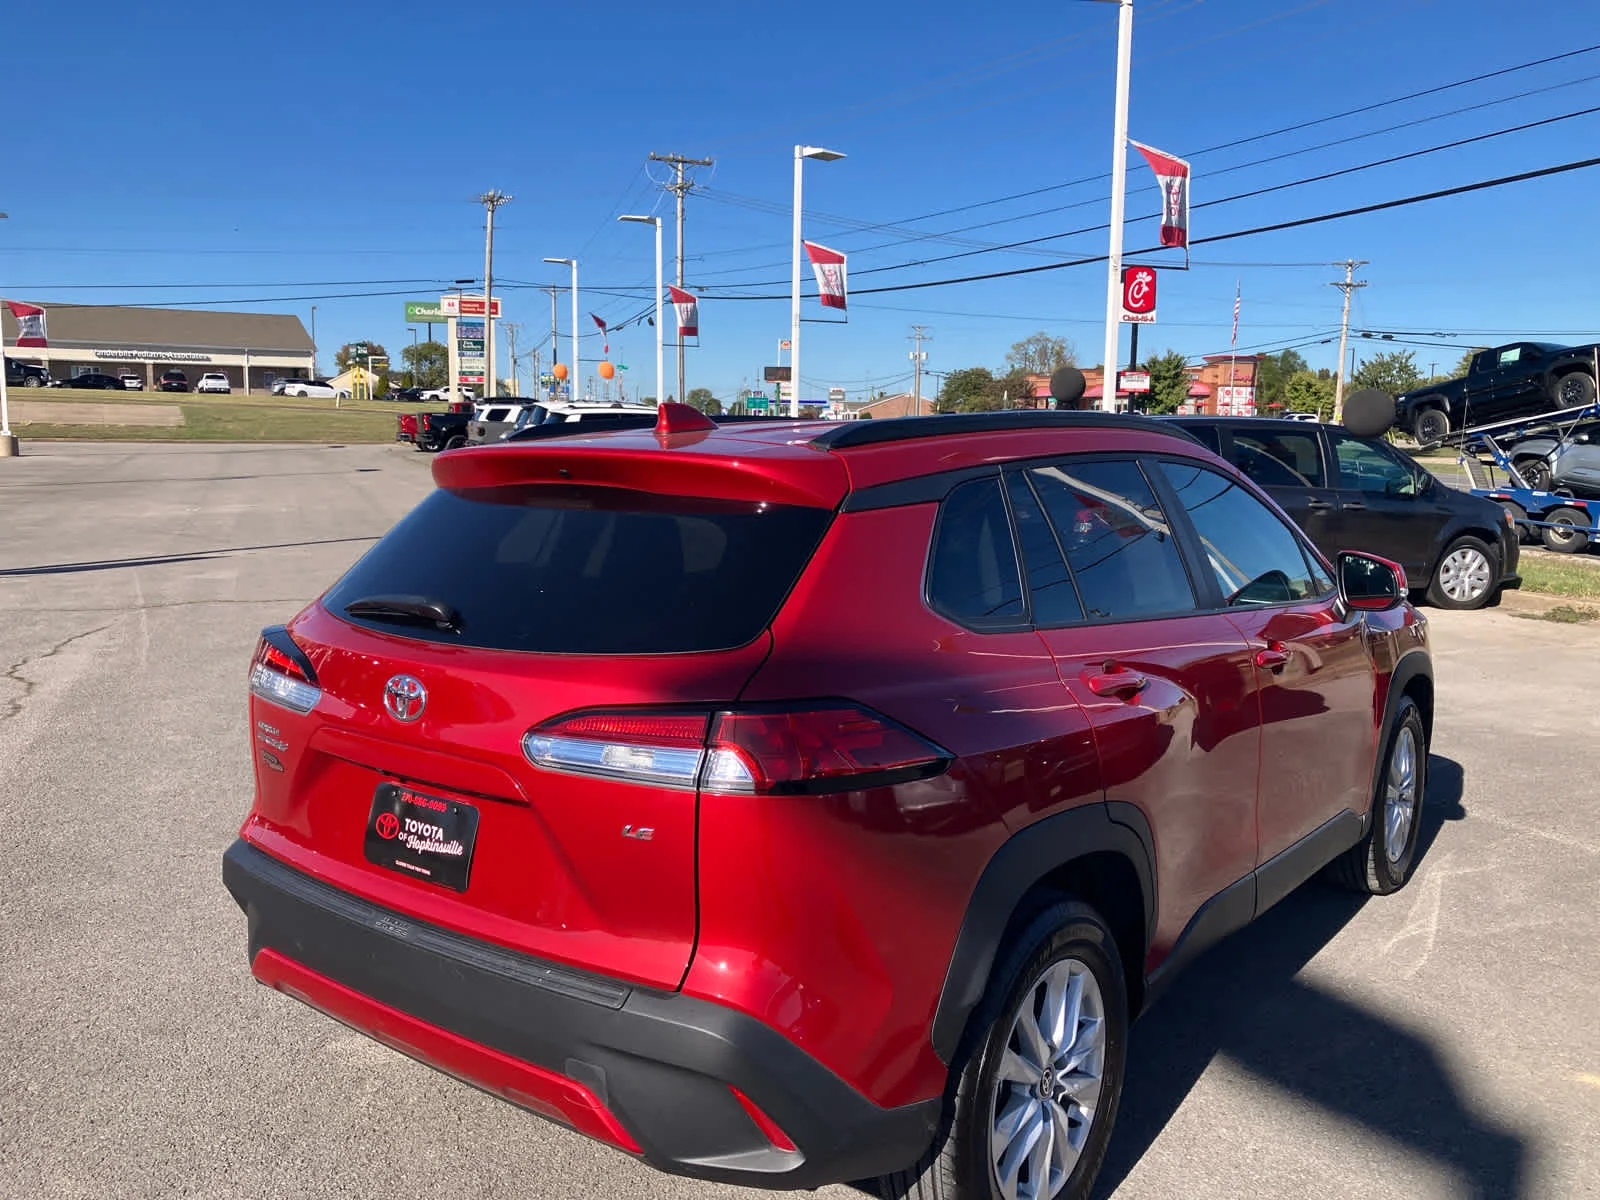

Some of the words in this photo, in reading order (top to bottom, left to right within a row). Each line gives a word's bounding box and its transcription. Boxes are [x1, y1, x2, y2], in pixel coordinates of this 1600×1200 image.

[405, 818, 443, 841] TOYOTA
[398, 832, 408, 841] OF
[406, 835, 463, 855] Hopkinsville
